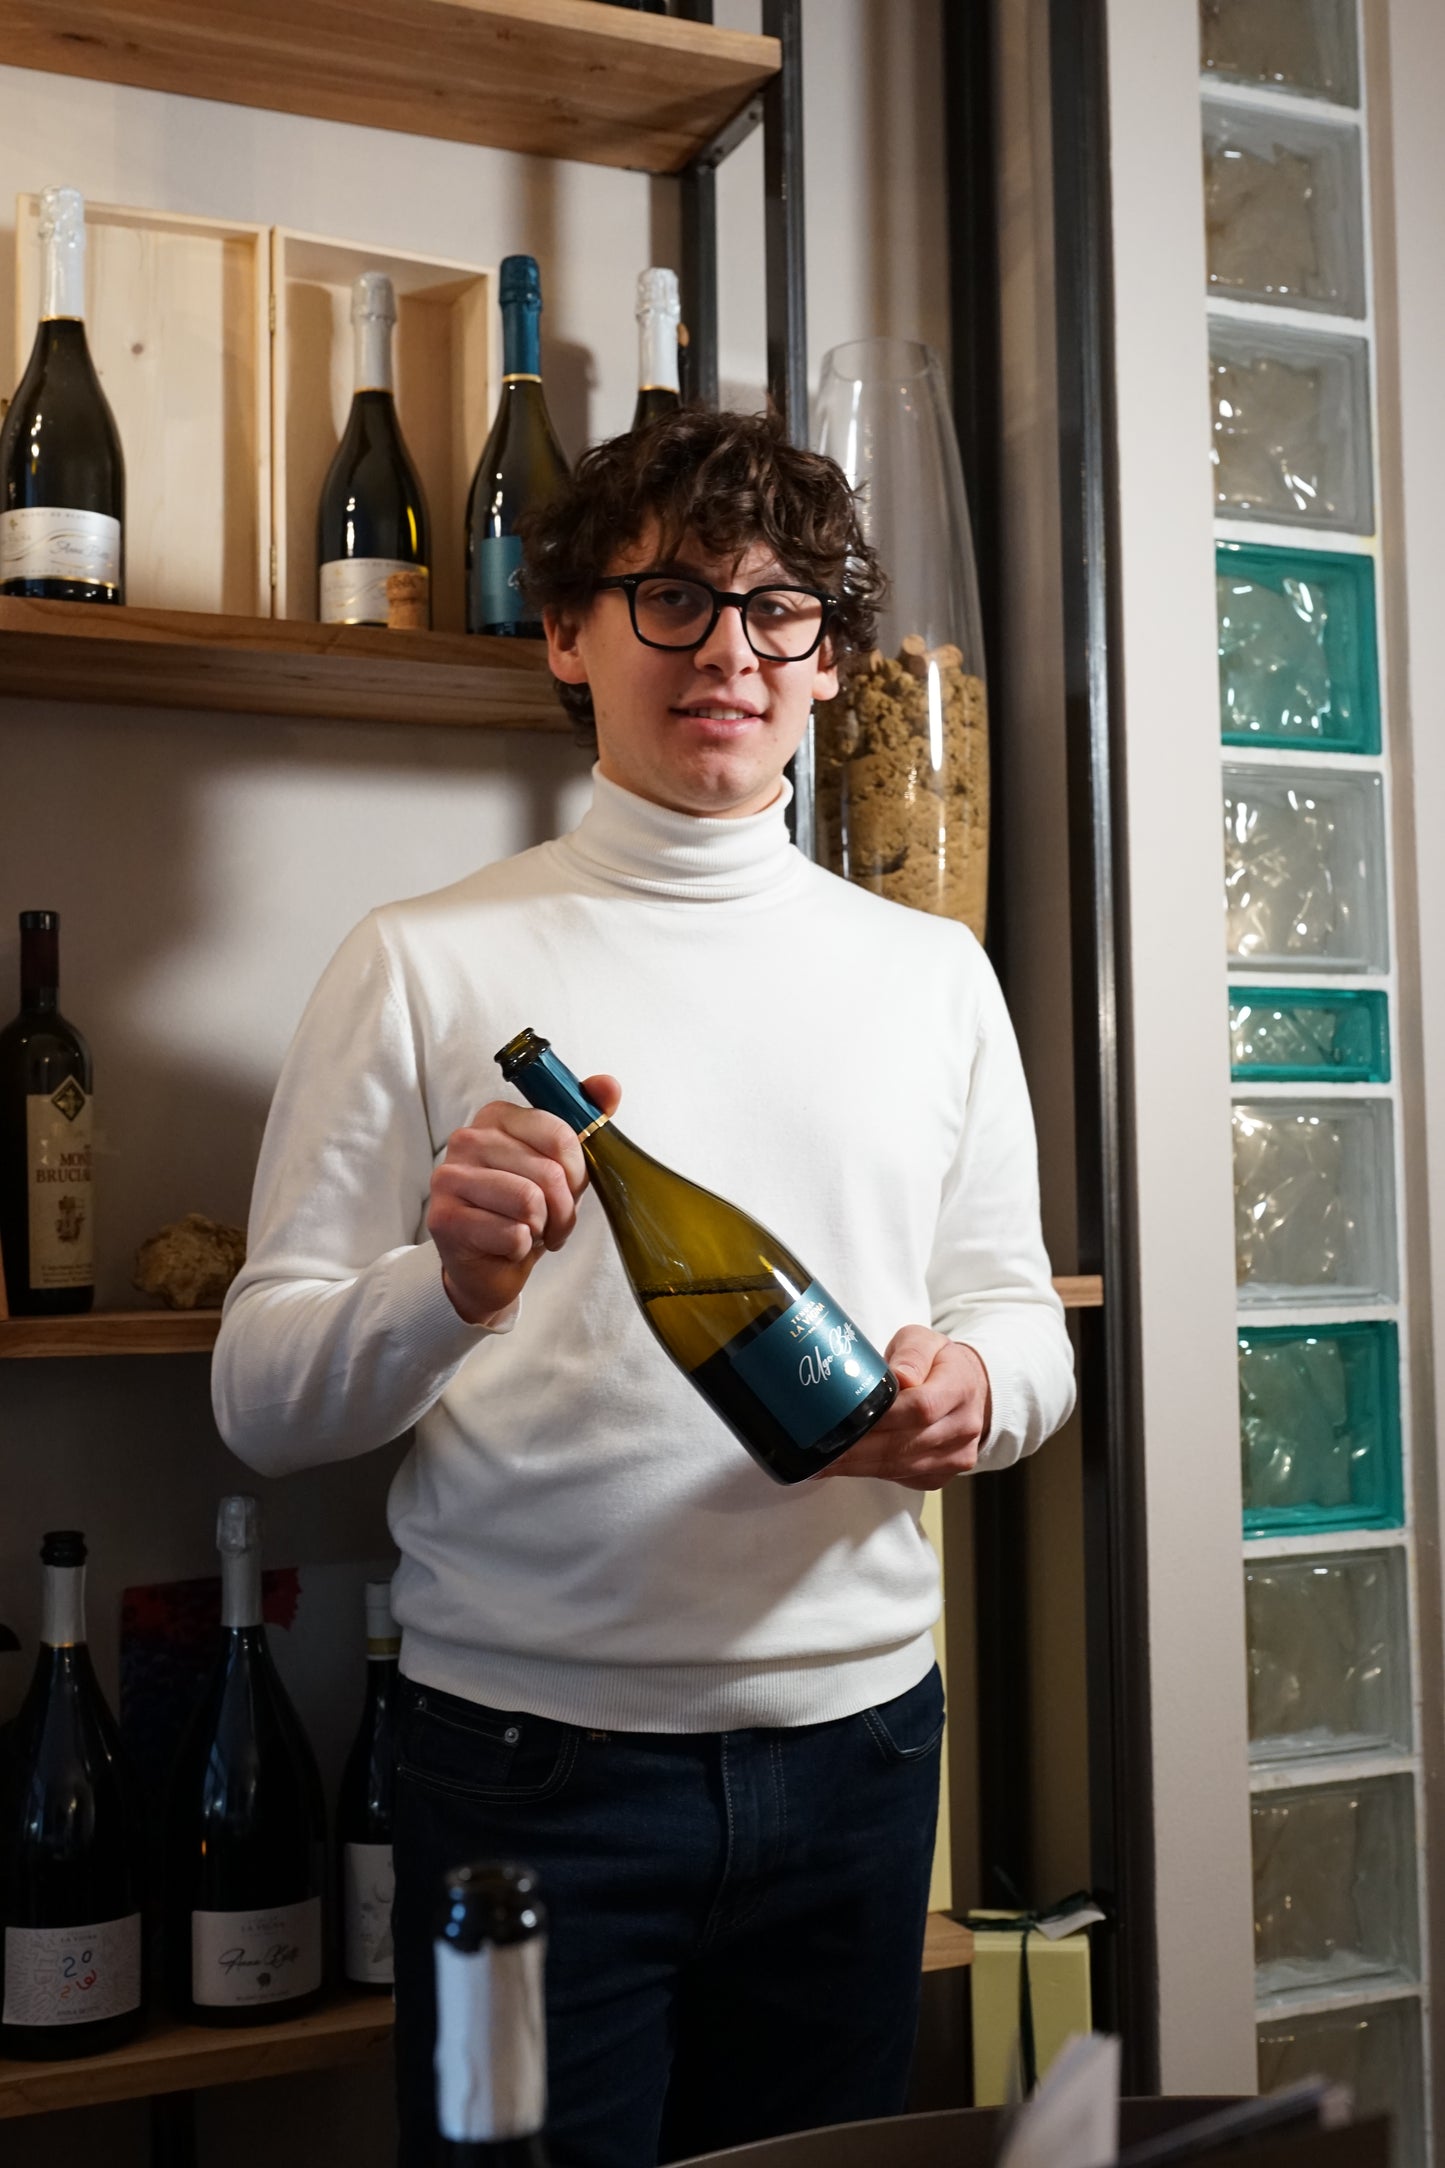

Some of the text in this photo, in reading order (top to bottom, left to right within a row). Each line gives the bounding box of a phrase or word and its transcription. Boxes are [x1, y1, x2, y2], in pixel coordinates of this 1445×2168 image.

[789, 1325, 805, 1338] LA
[802, 1302, 826, 1327] VIGNA
[799, 1345, 834, 1386] Ugo
